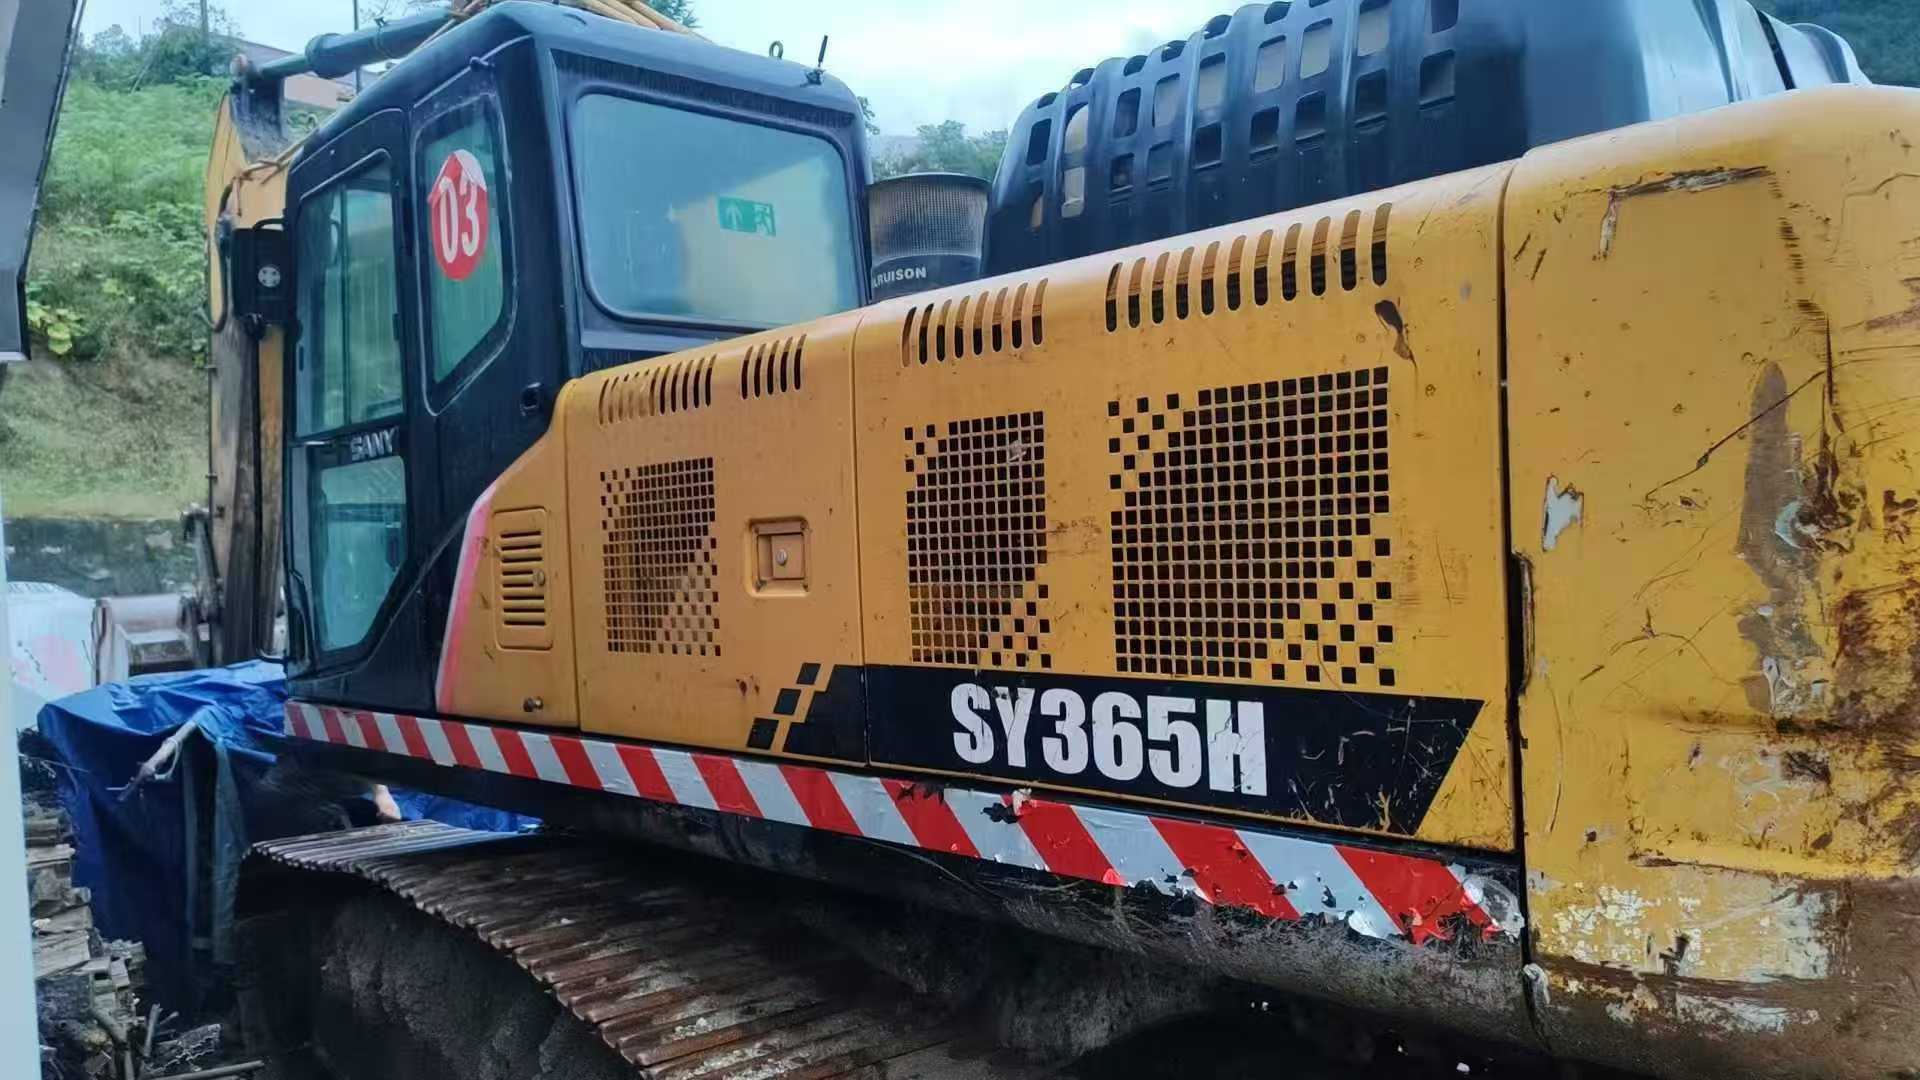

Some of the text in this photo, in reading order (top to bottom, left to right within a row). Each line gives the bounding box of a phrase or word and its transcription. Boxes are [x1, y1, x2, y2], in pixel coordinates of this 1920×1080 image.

[440, 170, 480, 263] 03
[352, 427, 399, 461] SANY
[951, 683, 1267, 796] SY365H
